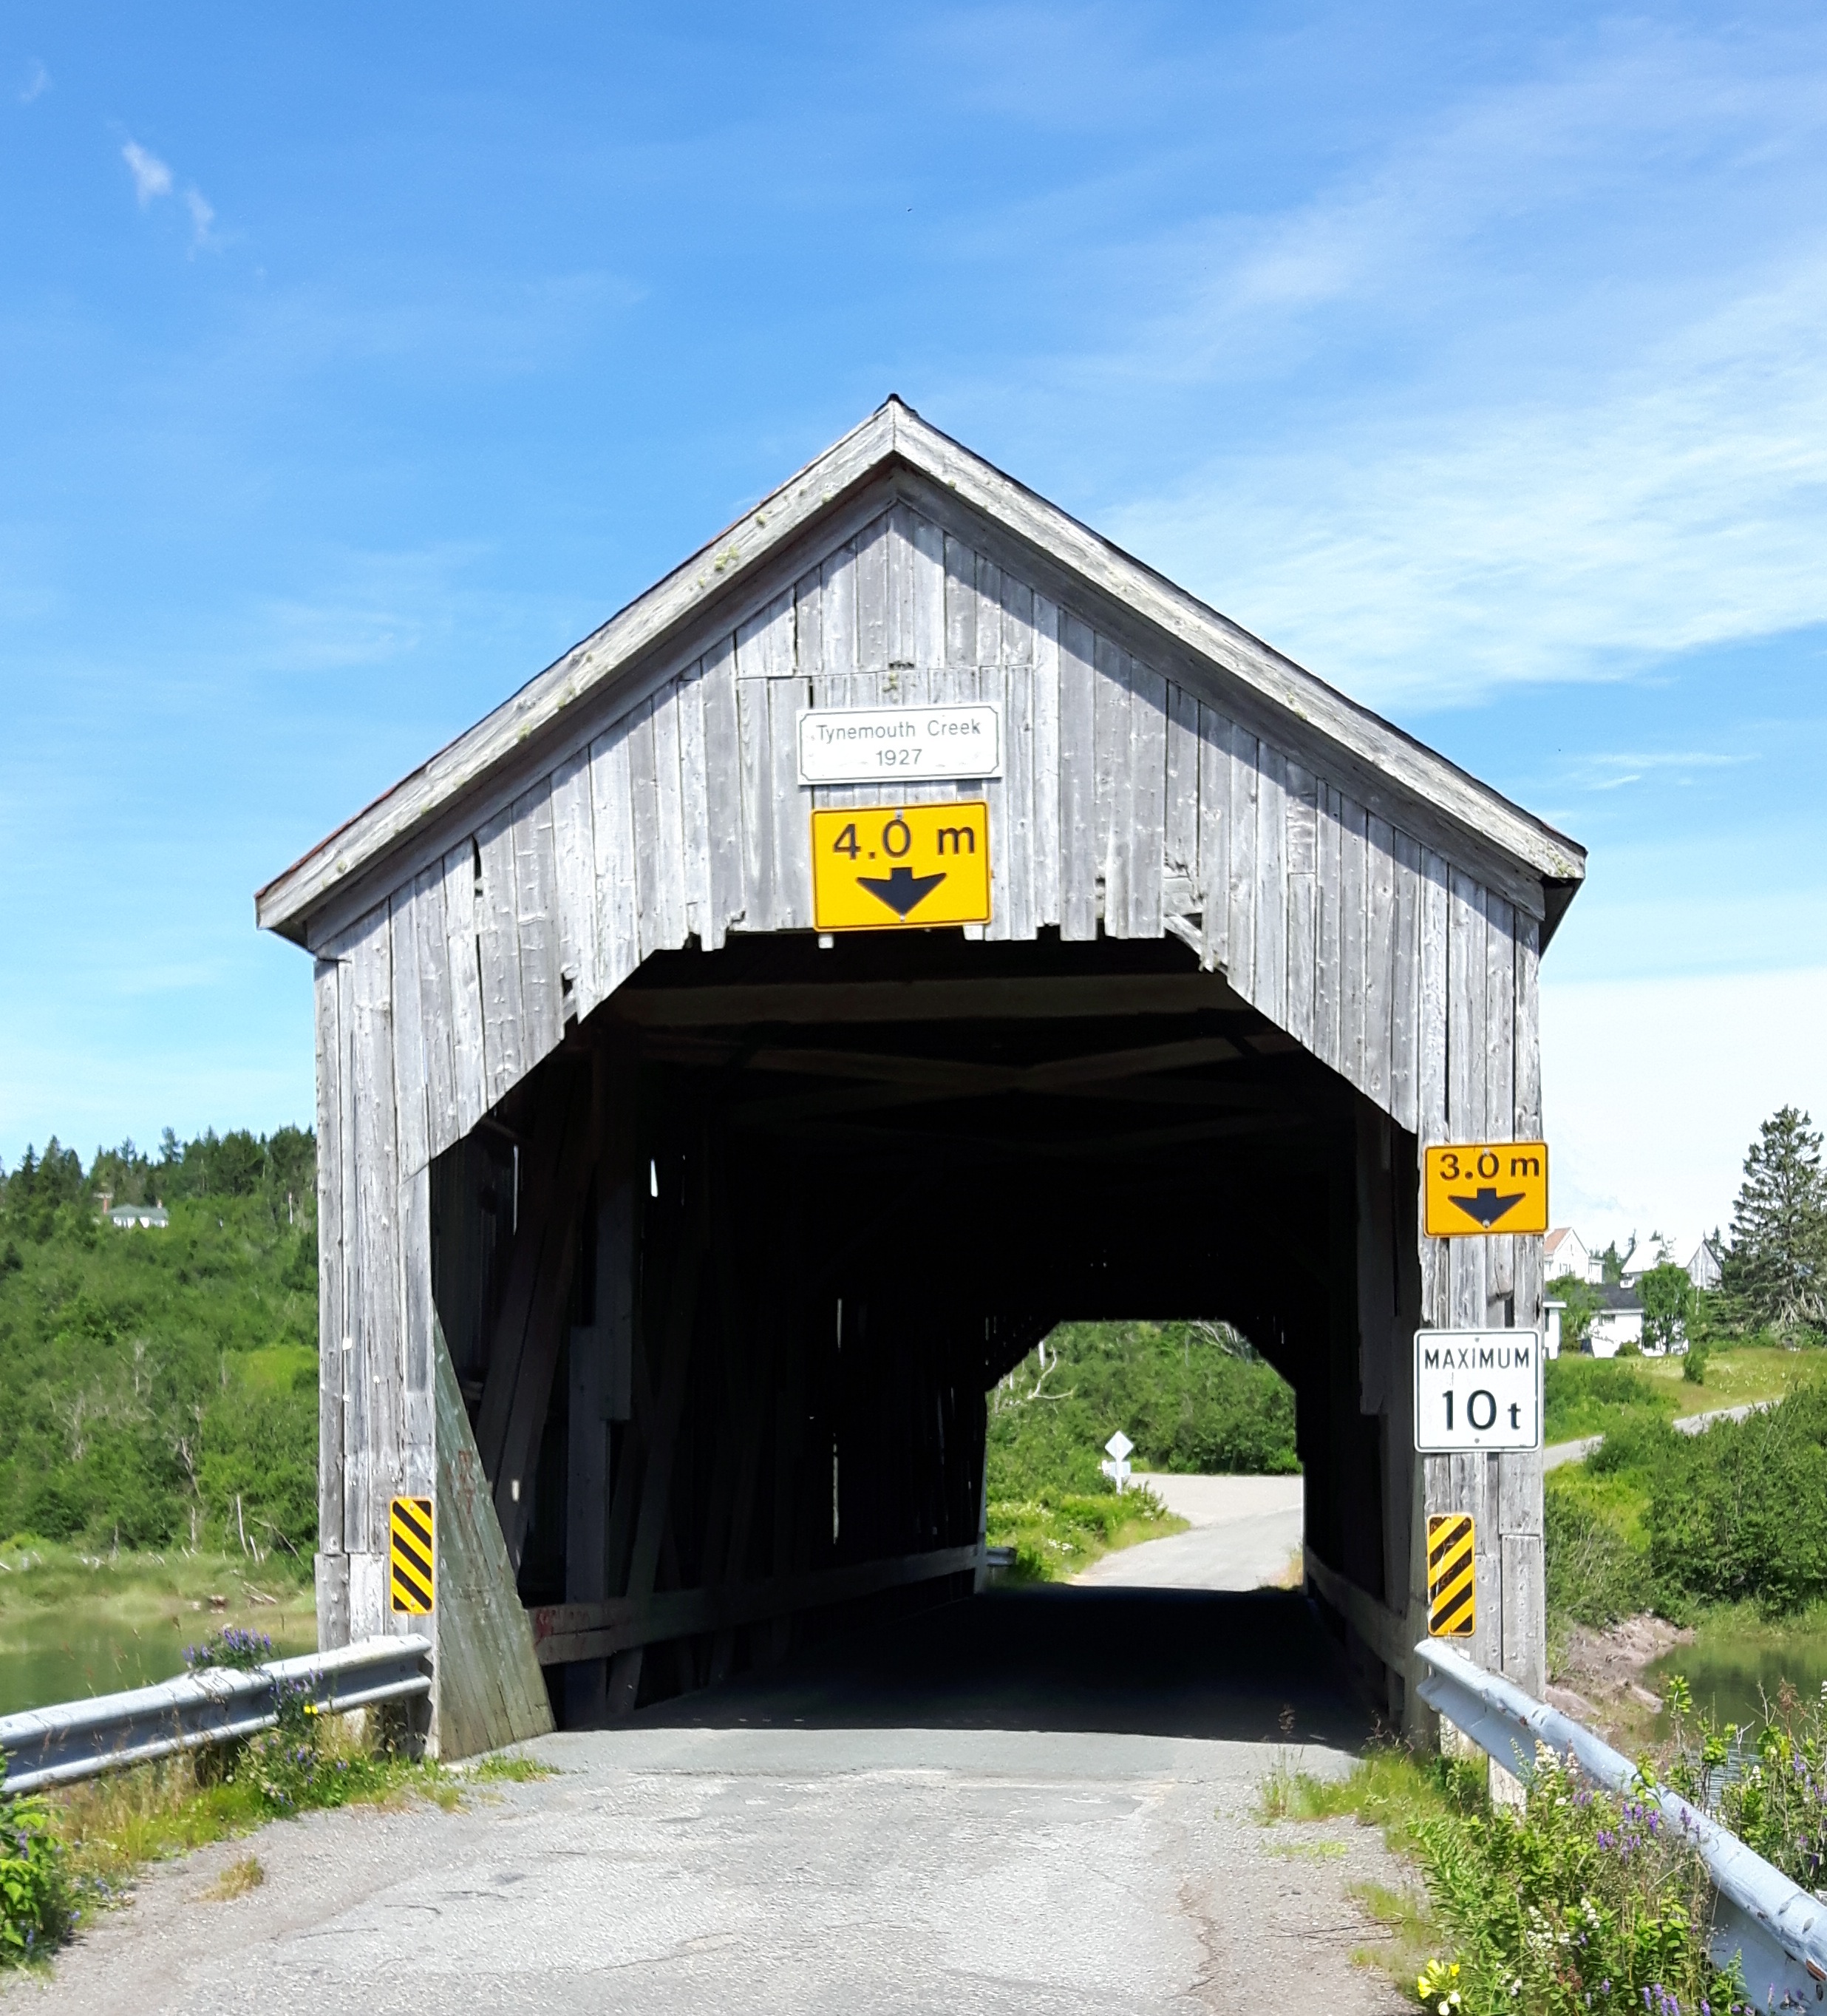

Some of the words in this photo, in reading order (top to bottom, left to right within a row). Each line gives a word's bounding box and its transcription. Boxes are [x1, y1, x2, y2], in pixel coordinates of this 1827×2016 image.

[816, 721, 916, 744] Tynemouth
[927, 719, 981, 736] Creek
[875, 748, 922, 767] 1927
[832, 818, 912, 861] 4.0
[936, 825, 976, 856] m
[1440, 1153, 1500, 1181] 3.0
[1510, 1155, 1539, 1178] m
[1424, 1348, 1530, 1370] MAXIMUM
